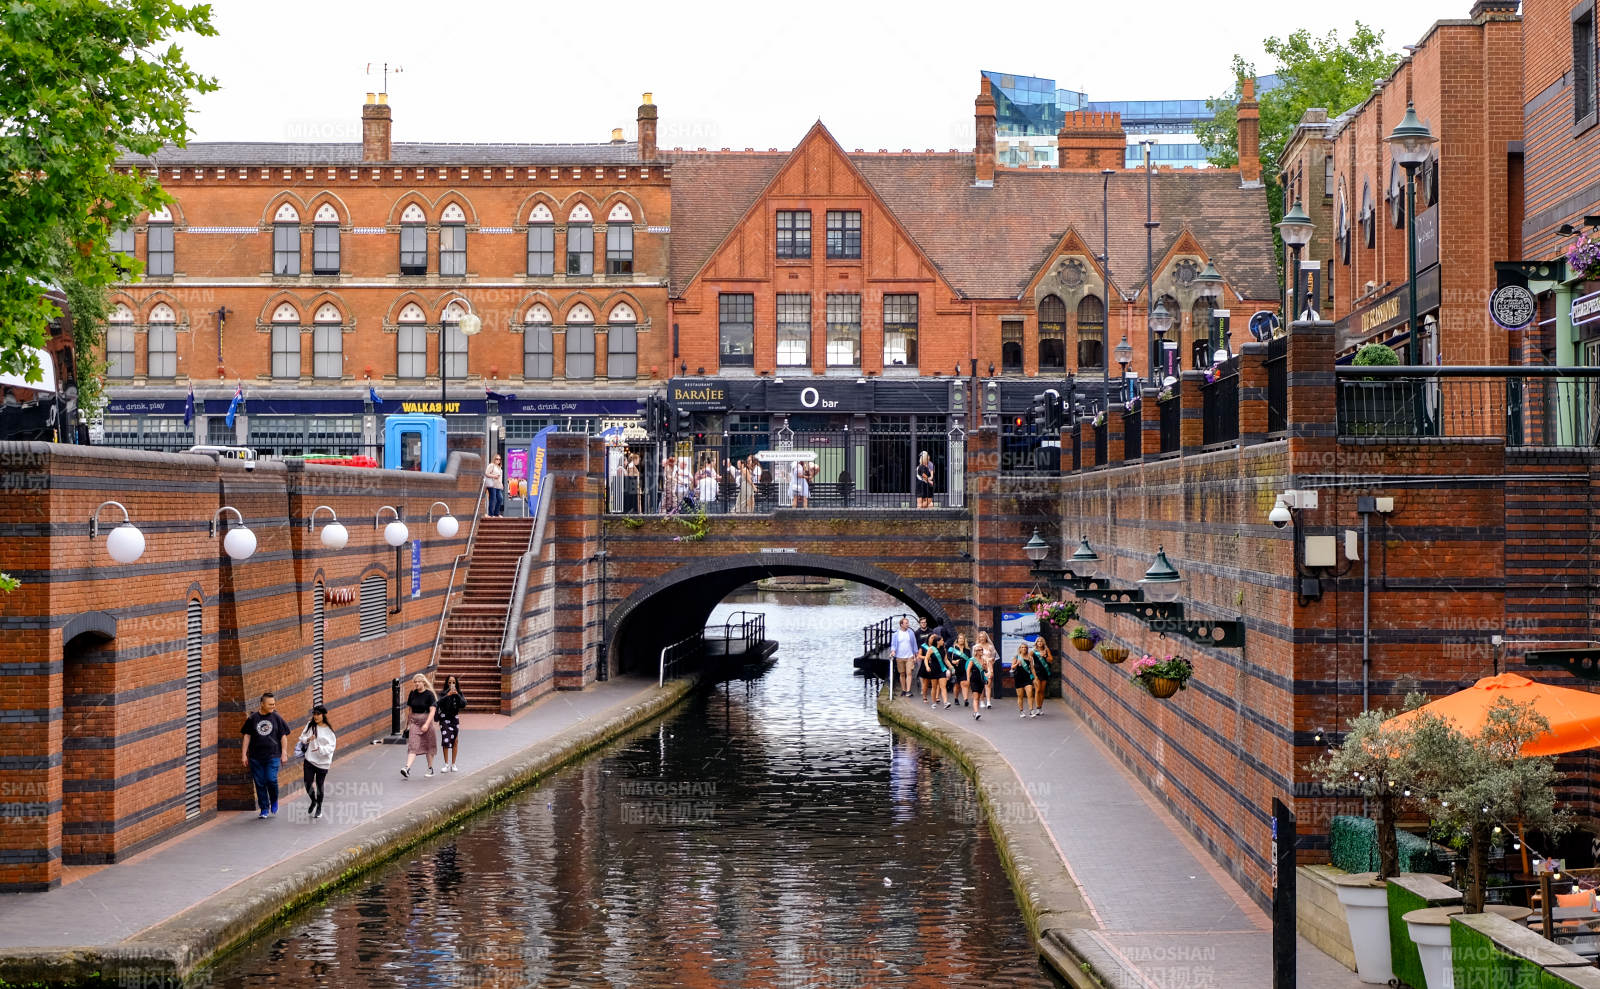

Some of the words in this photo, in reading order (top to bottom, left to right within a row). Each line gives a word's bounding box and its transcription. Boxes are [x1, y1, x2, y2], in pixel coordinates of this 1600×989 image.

[800, 387, 820, 408] O
[822, 398, 839, 408] bar
[126, 402, 148, 410] drink,
[149, 402, 165, 410] play
[561, 403, 577, 411] play
